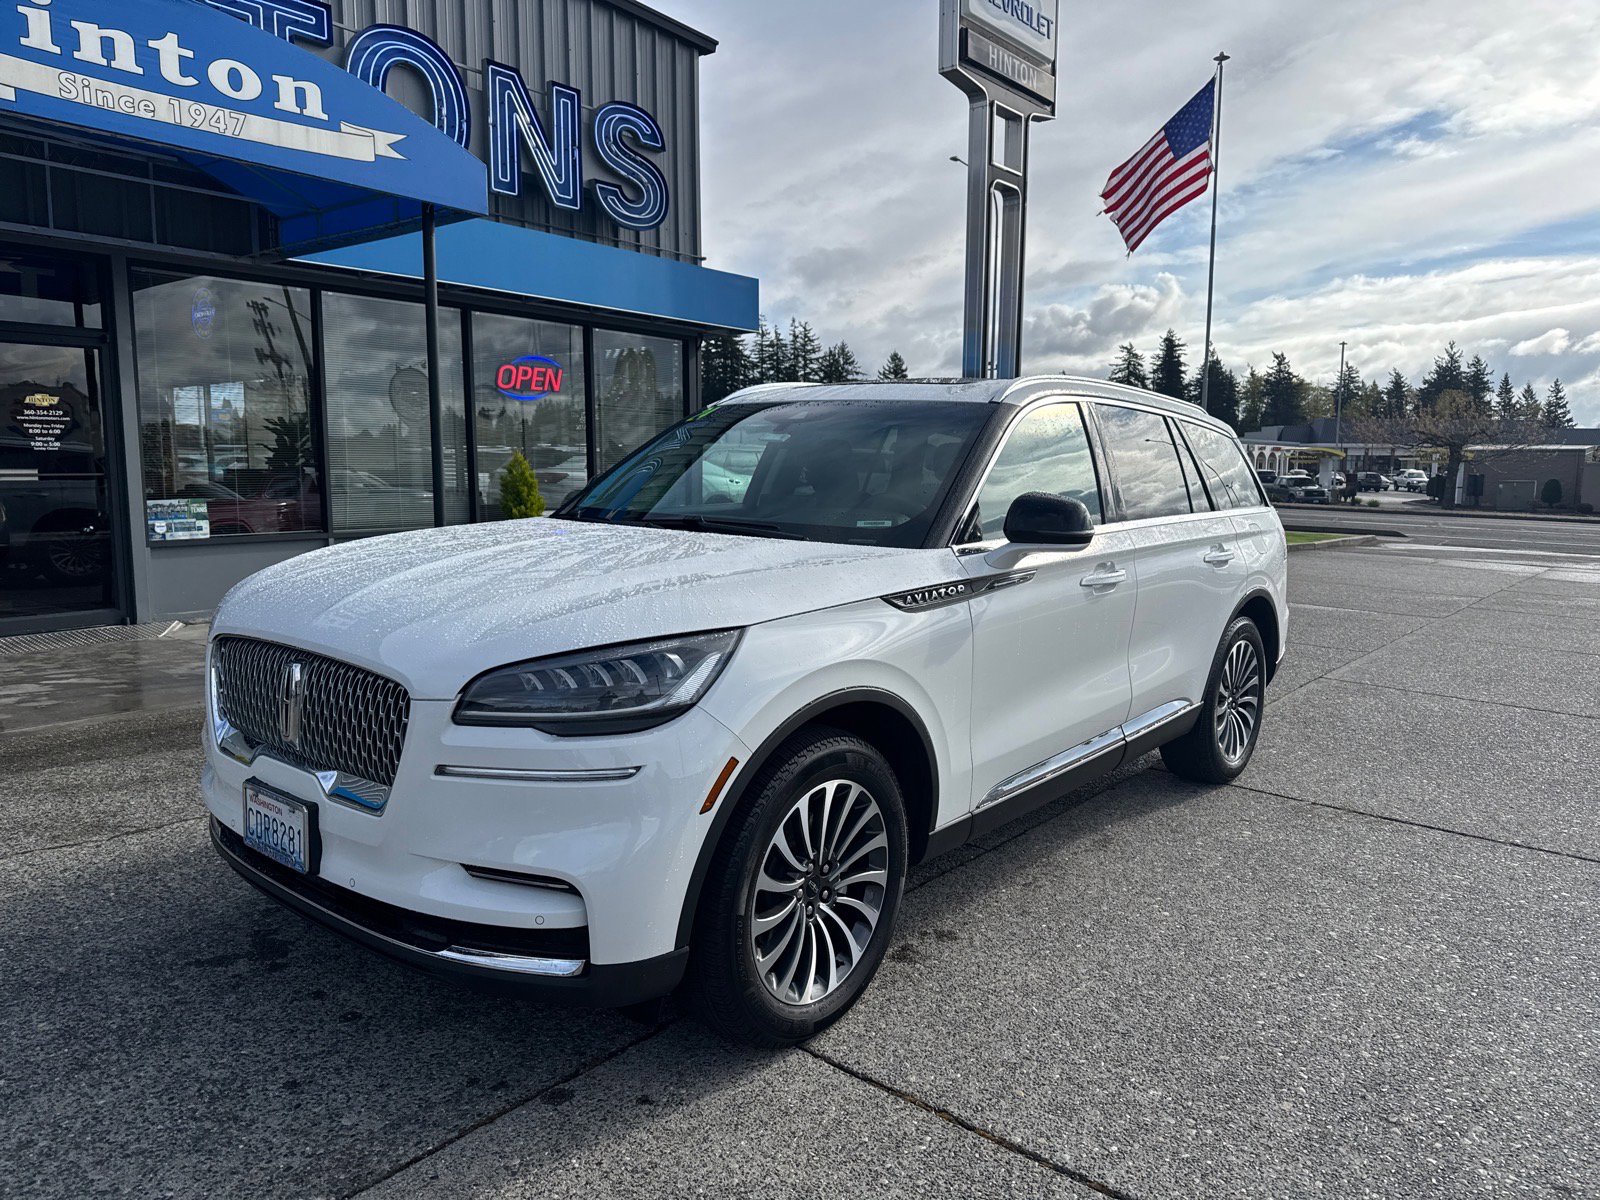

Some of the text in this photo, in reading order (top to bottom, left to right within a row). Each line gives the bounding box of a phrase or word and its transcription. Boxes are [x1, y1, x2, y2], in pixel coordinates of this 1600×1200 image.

[16, 0, 329, 121] inton
[988, 45, 1037, 90] HINTON
[57, 71, 247, 137] Since 1947
[497, 364, 563, 392] OPEN
[905, 584, 965, 605] AVIATOR
[249, 792, 283, 817] WASHINGTON
[247, 807, 302, 860] CDR8281
